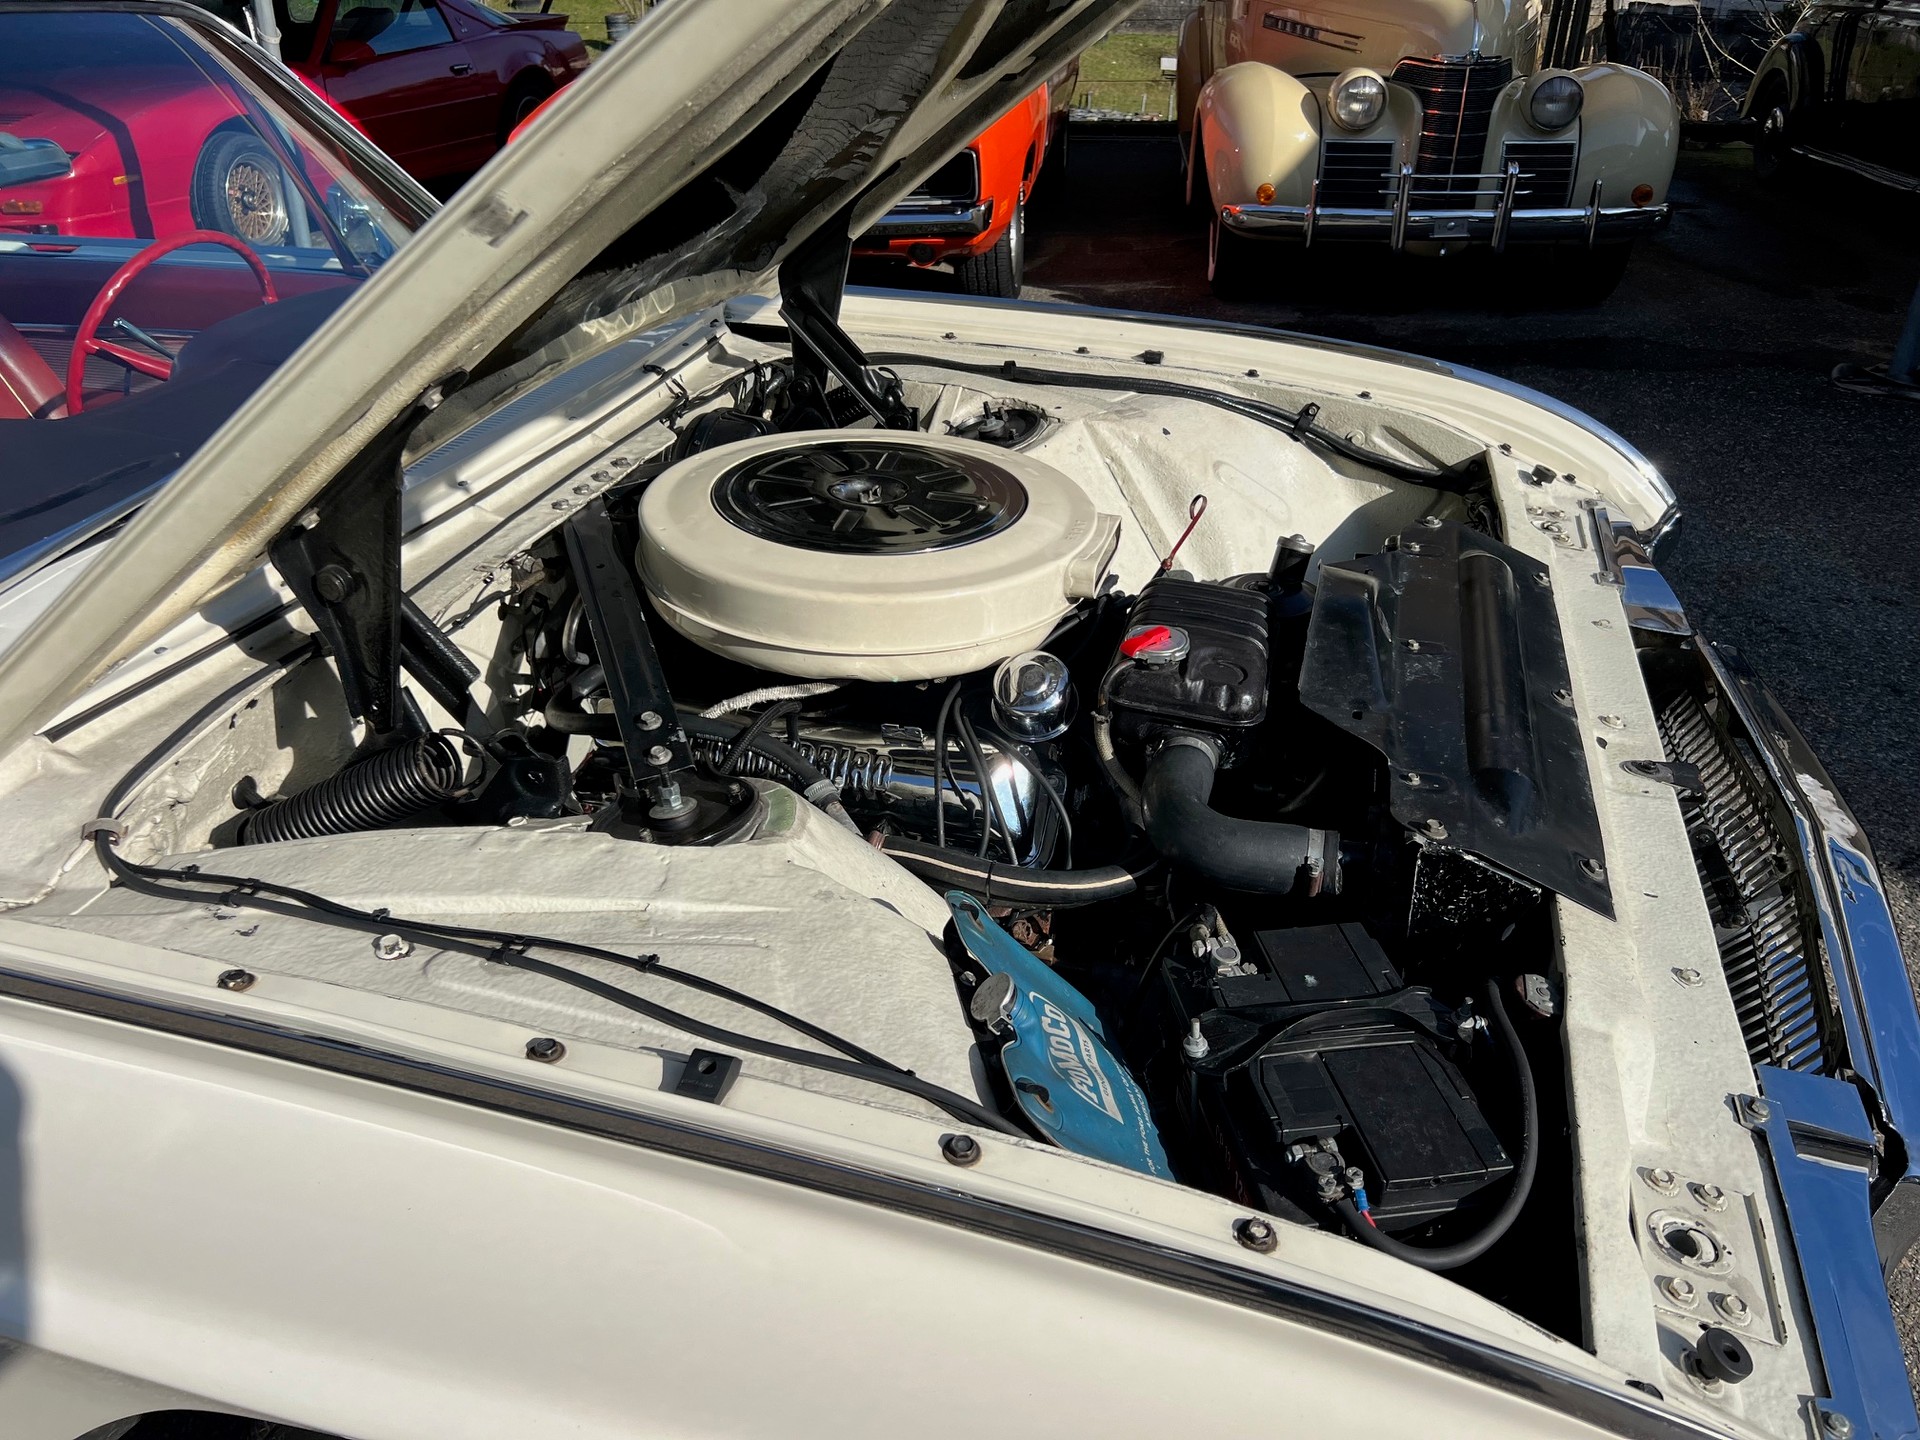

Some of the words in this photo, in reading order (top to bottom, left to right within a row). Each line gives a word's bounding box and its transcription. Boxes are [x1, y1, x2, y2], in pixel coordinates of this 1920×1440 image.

[1082, 1039, 1095, 1065] PARTS
[1126, 1086, 1141, 1116] FAMILY
[1137, 1116, 1147, 1139] FORD
[1141, 1138, 1150, 1156] THE
[1147, 1157, 1157, 1175] FOR
